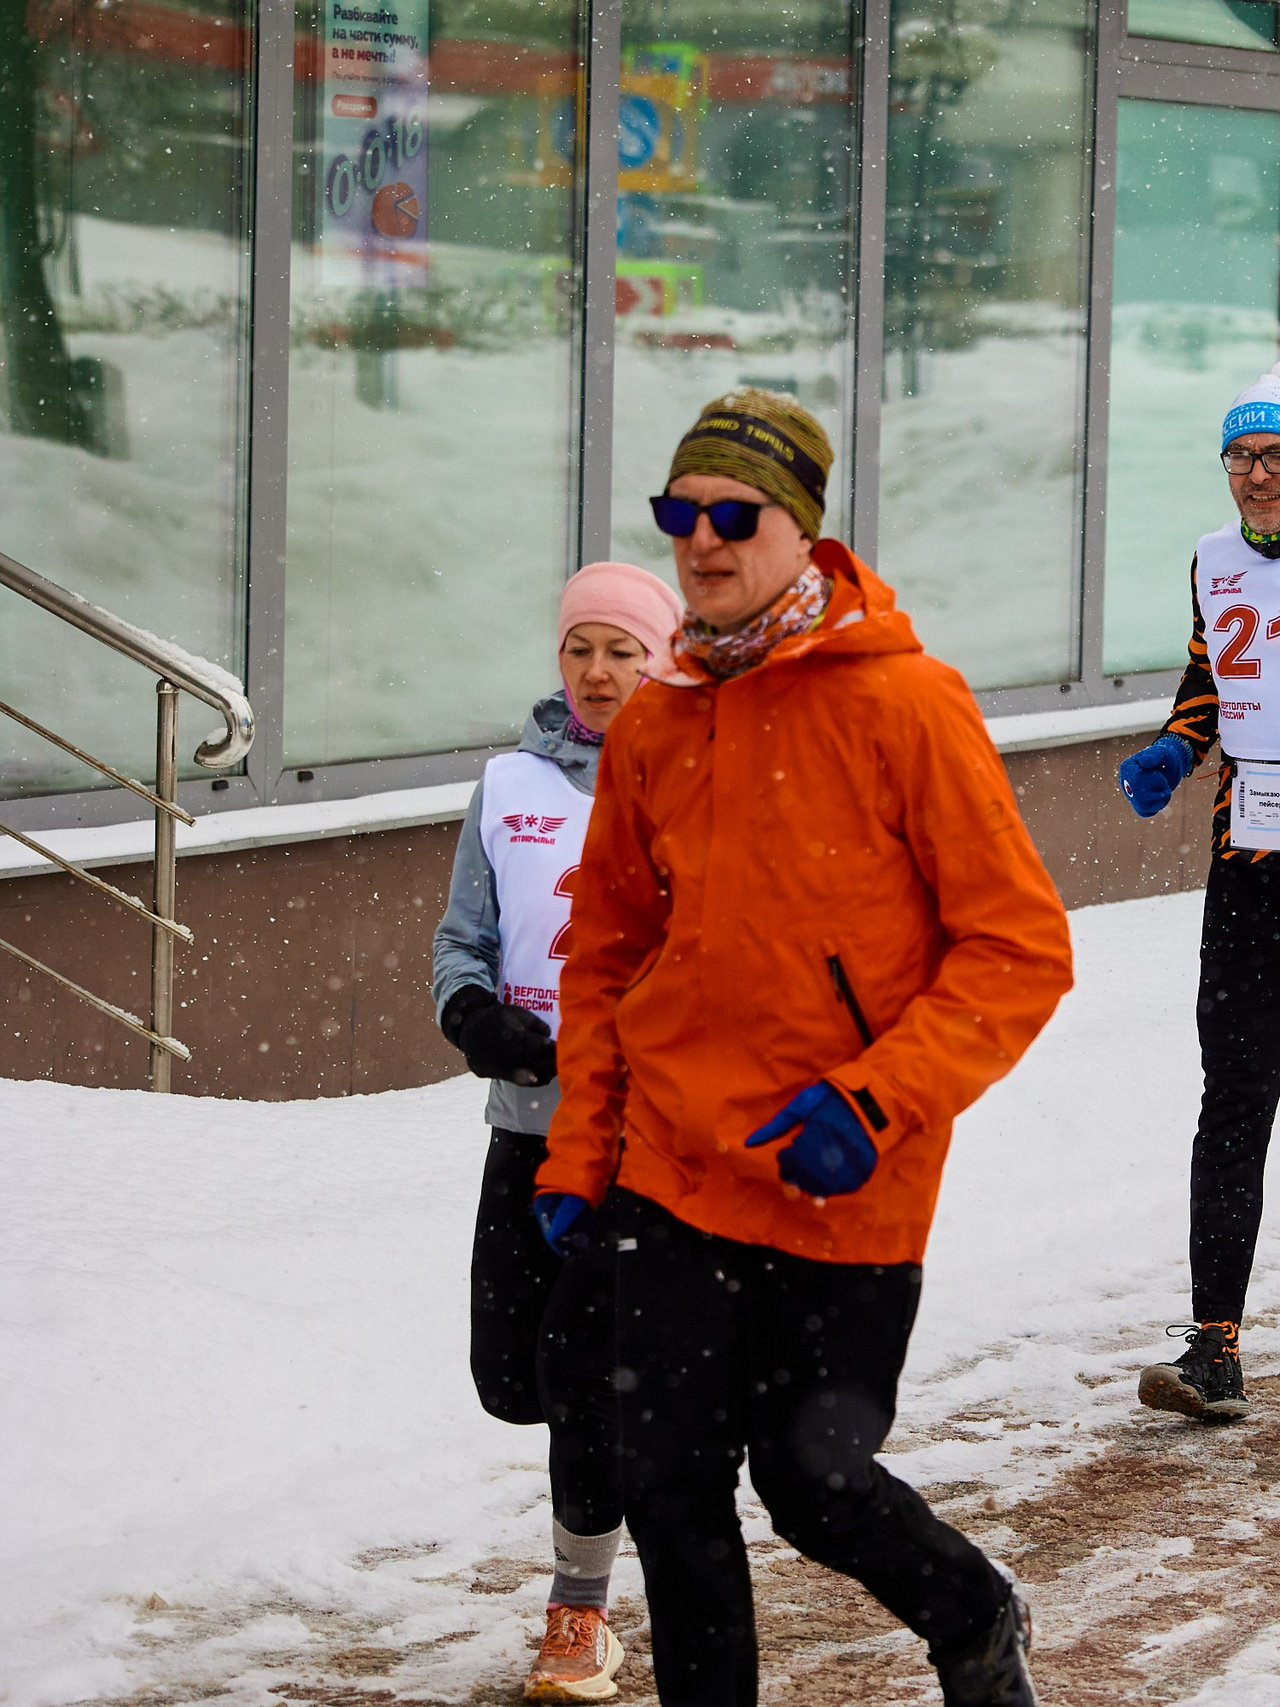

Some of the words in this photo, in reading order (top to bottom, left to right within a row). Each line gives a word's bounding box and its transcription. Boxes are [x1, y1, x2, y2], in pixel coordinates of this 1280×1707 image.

[333, 4, 398, 25] Разбивайте
[332, 28, 347, 40] на
[350, 29, 381, 43] части
[383, 32, 419, 50] сумму,
[332, 47, 339, 59] а
[341, 48, 355, 60] не
[357, 49, 396, 63] мечты!
[514, 986, 559, 1000] ВЕРТОЛЕ
[513, 998, 553, 1012] РОССИИ
